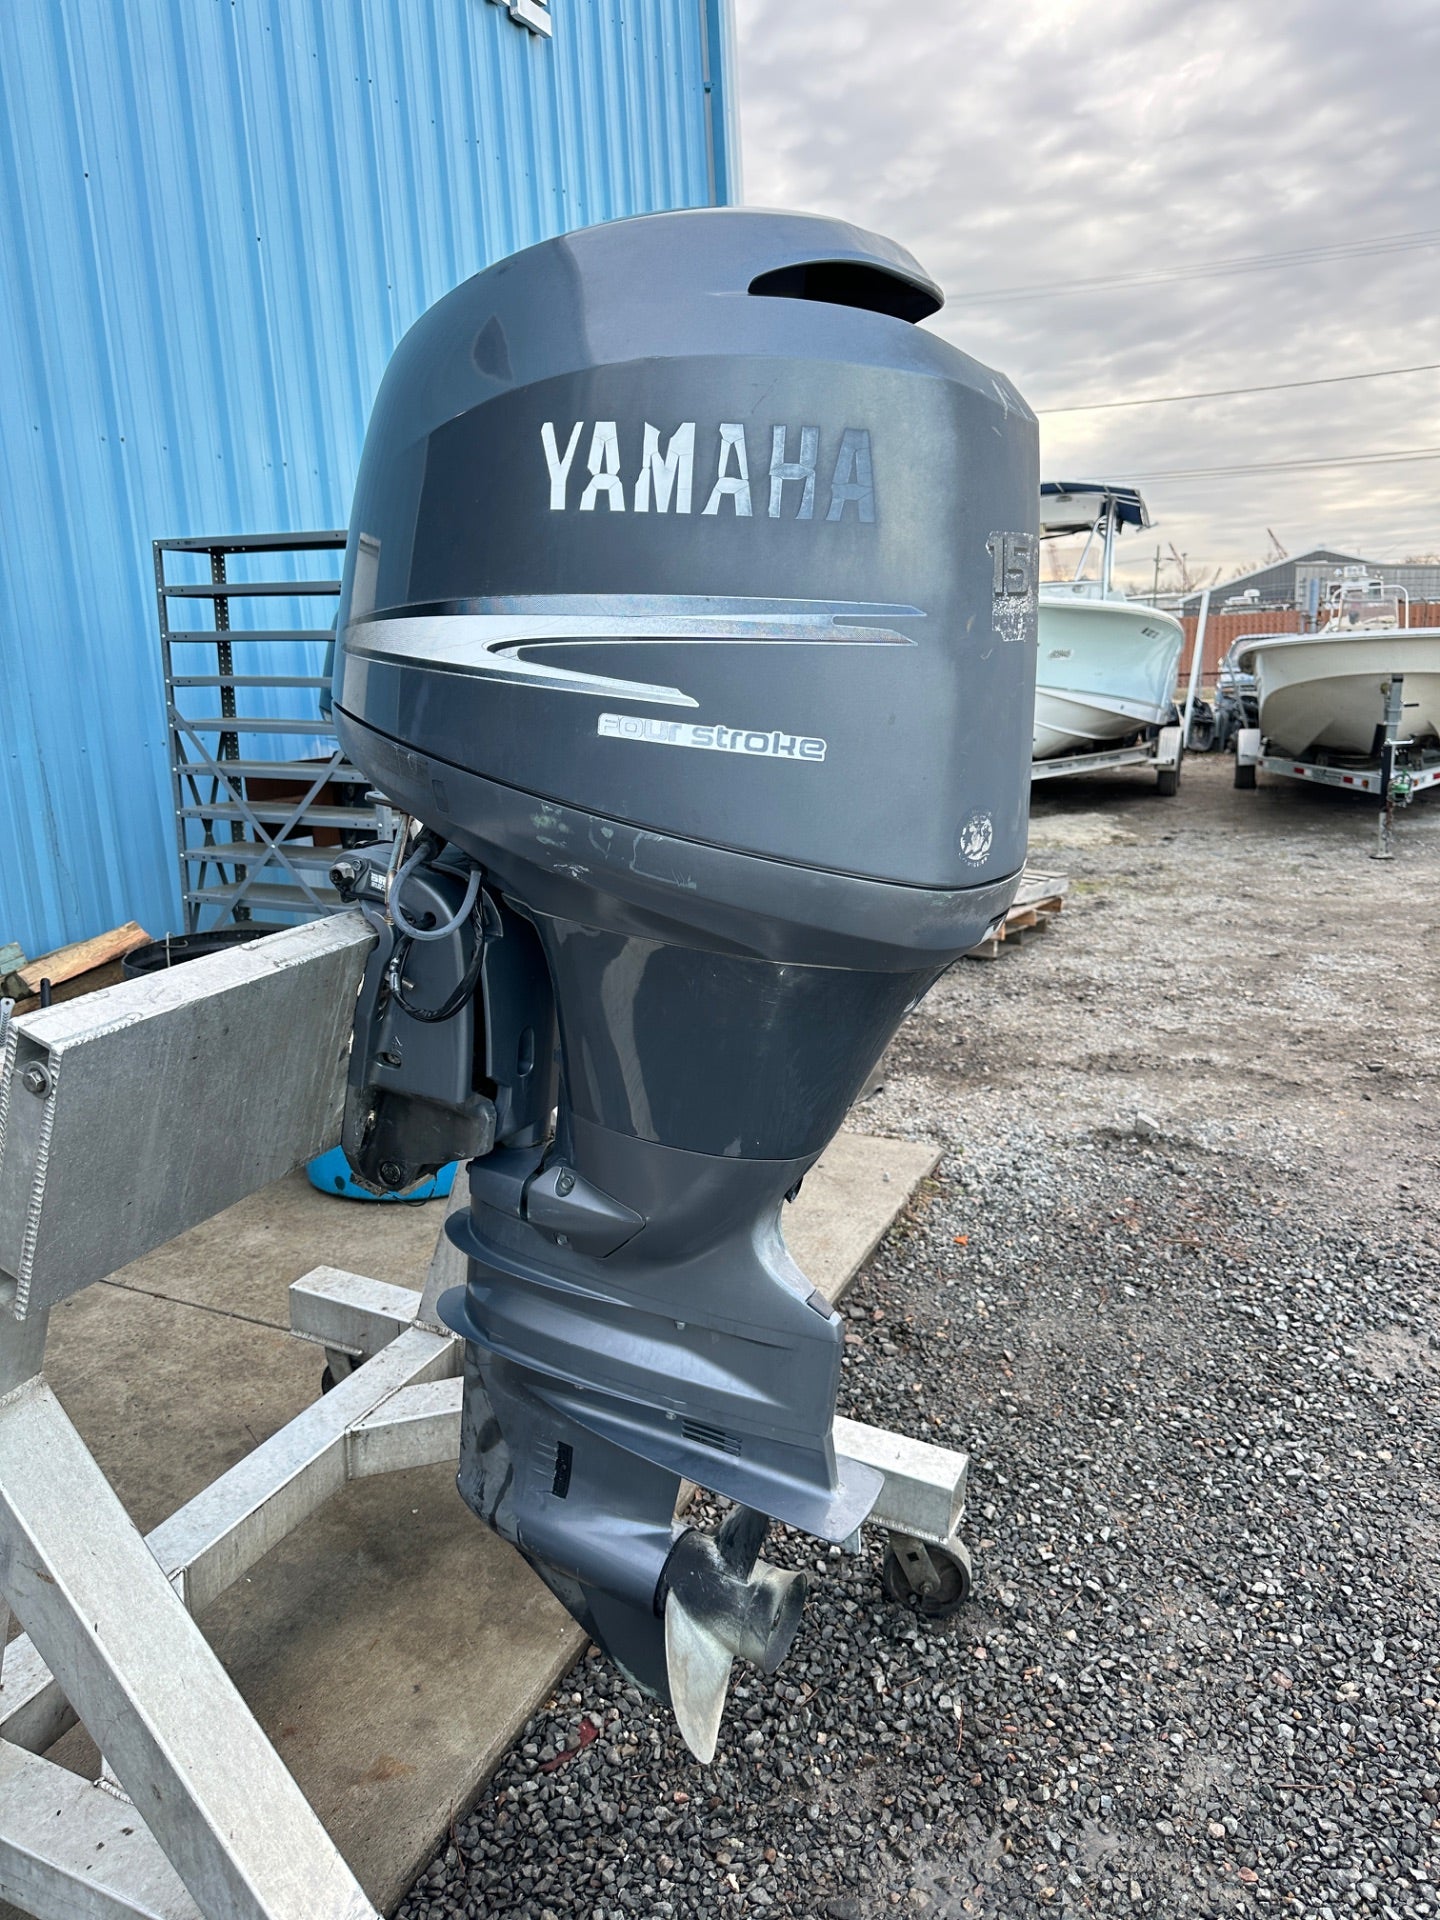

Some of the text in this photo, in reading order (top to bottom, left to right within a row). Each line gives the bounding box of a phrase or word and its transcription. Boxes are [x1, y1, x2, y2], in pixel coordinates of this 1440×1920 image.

[541, 421, 876, 523] YAMAHA
[988, 536, 1039, 597] 15
[691, 726, 826, 760] stroke
